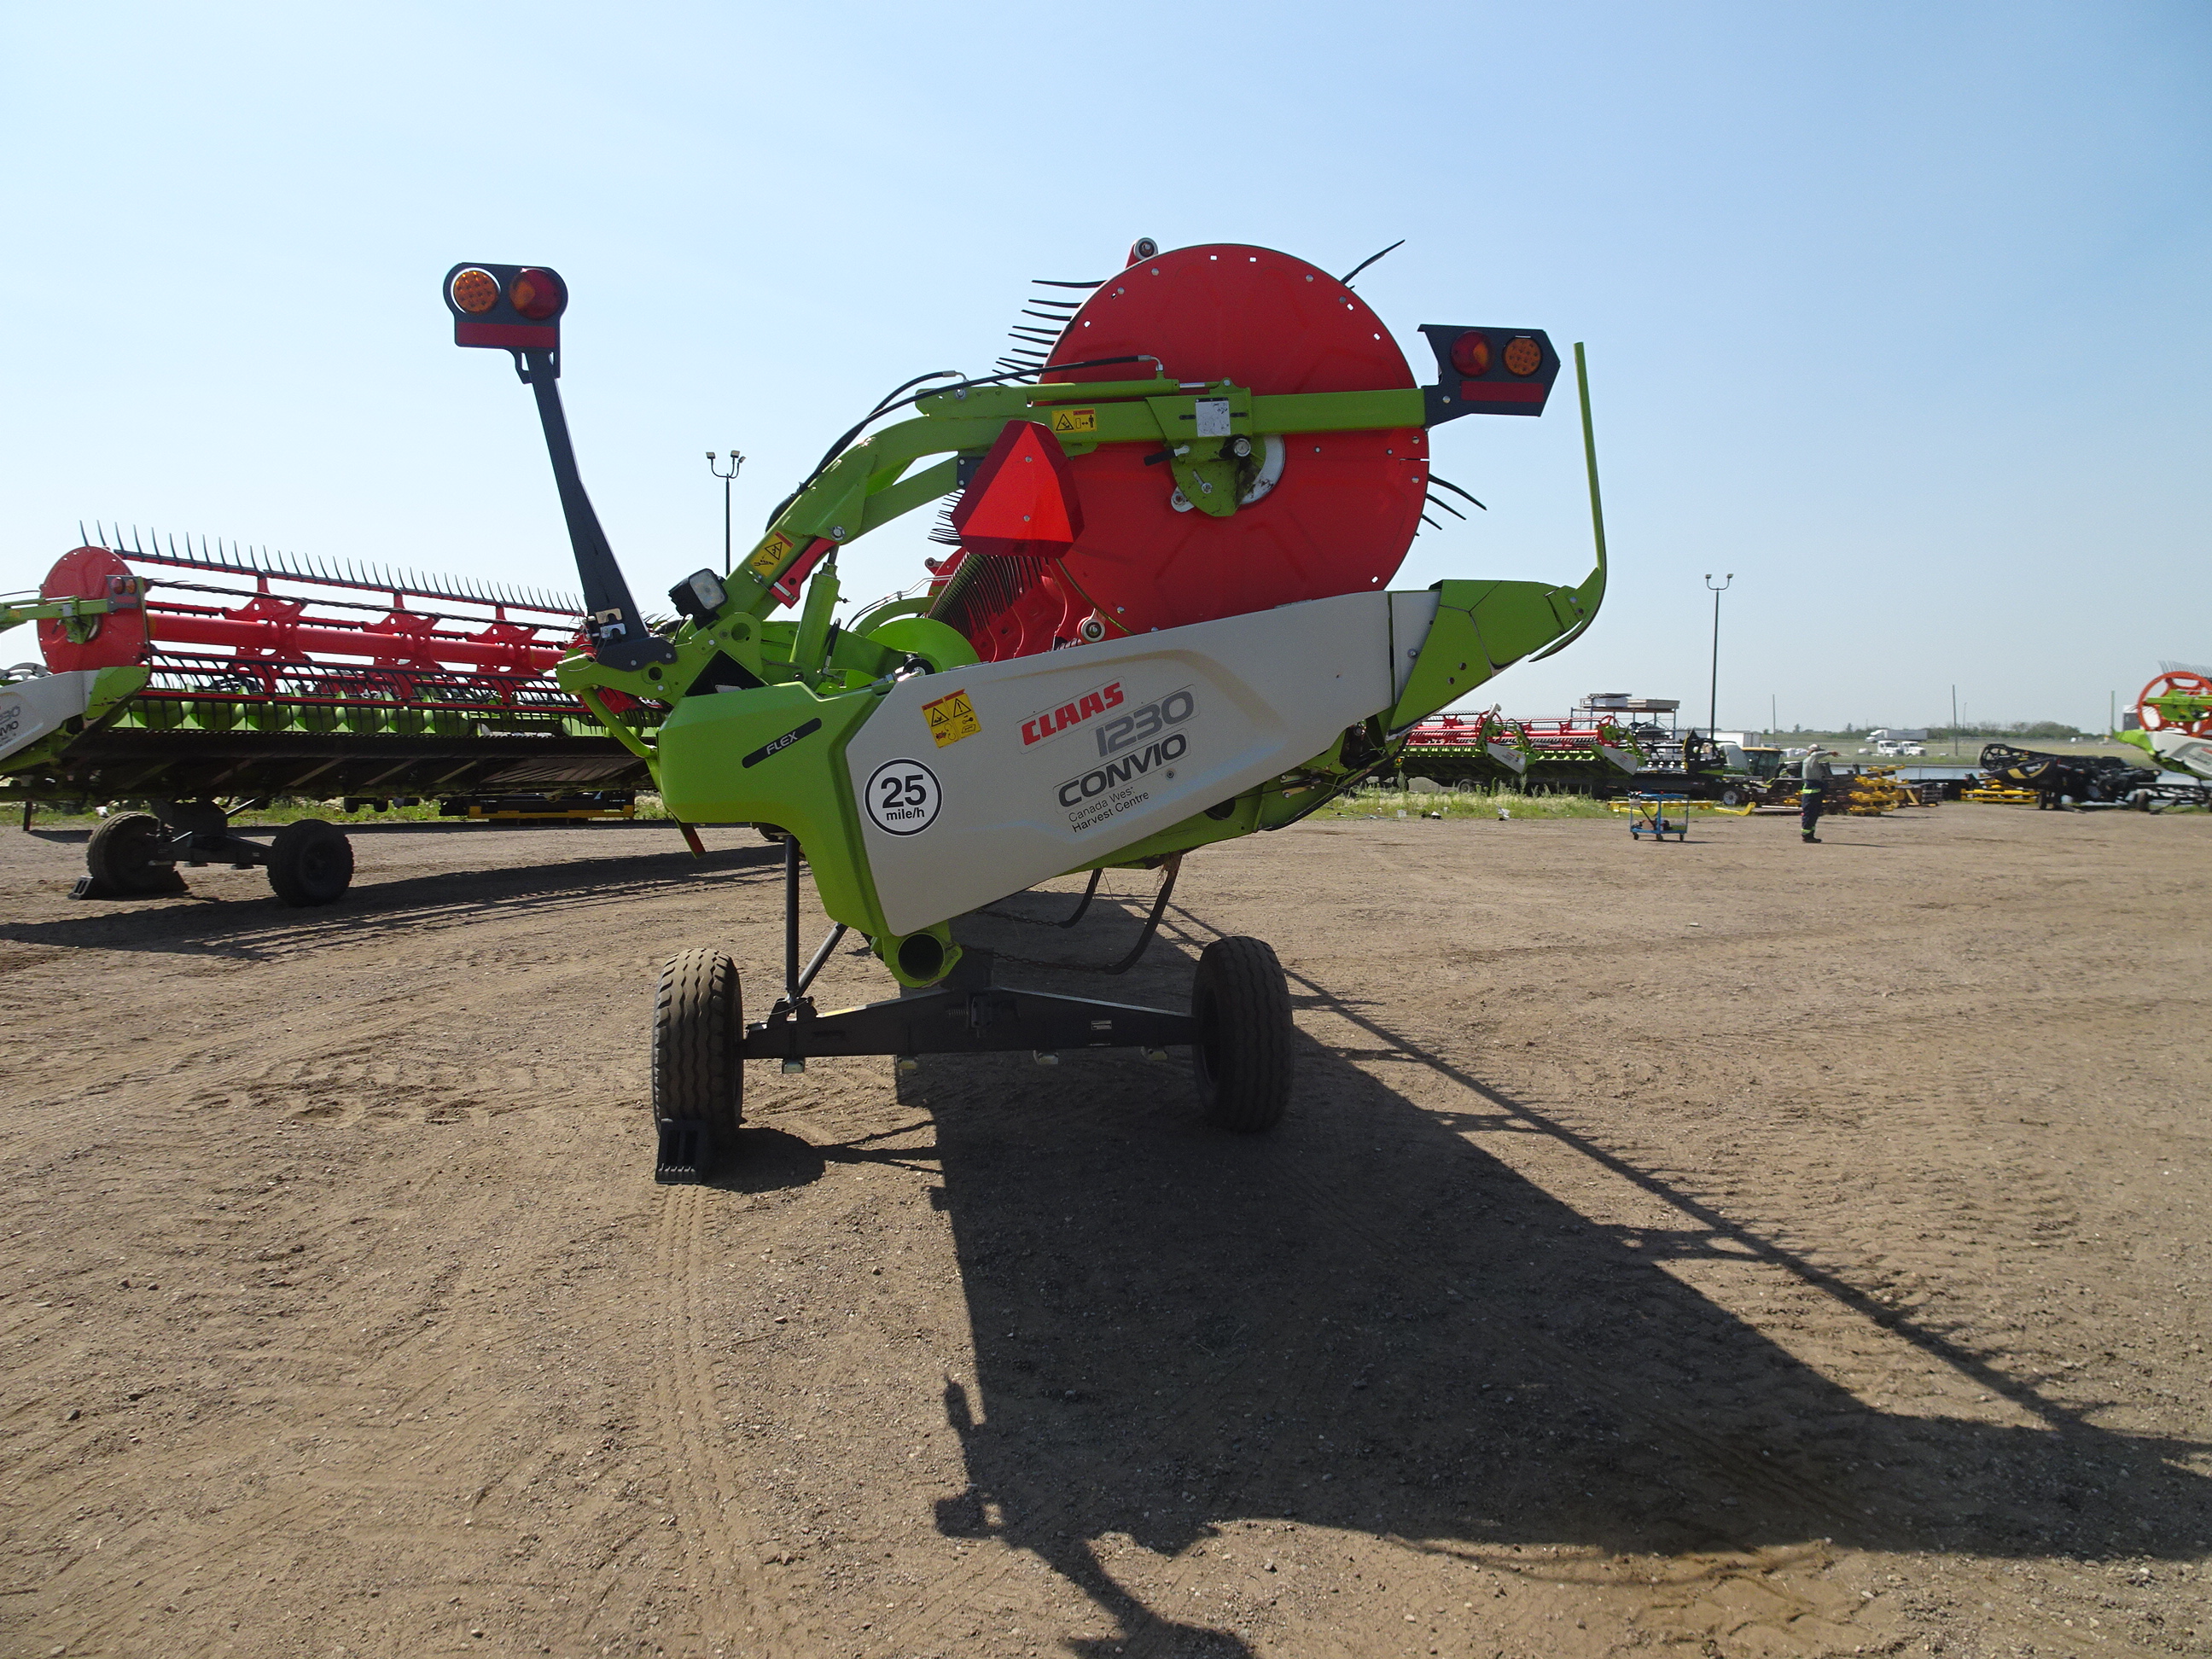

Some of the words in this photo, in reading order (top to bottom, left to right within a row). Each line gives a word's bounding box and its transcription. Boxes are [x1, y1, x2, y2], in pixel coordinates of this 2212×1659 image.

[1022, 682, 1124, 746] CLAAS
[1095, 691, 1195, 758] 1230
[766, 731, 798, 755] FLEX
[1058, 733, 1187, 807] CONVIO
[881, 774, 927, 809] 25
[886, 806, 925, 821] mile/h
[1068, 799, 1109, 823] Canada
[1072, 807, 1114, 833] Harvest
[1115, 791, 1150, 812] Centre
